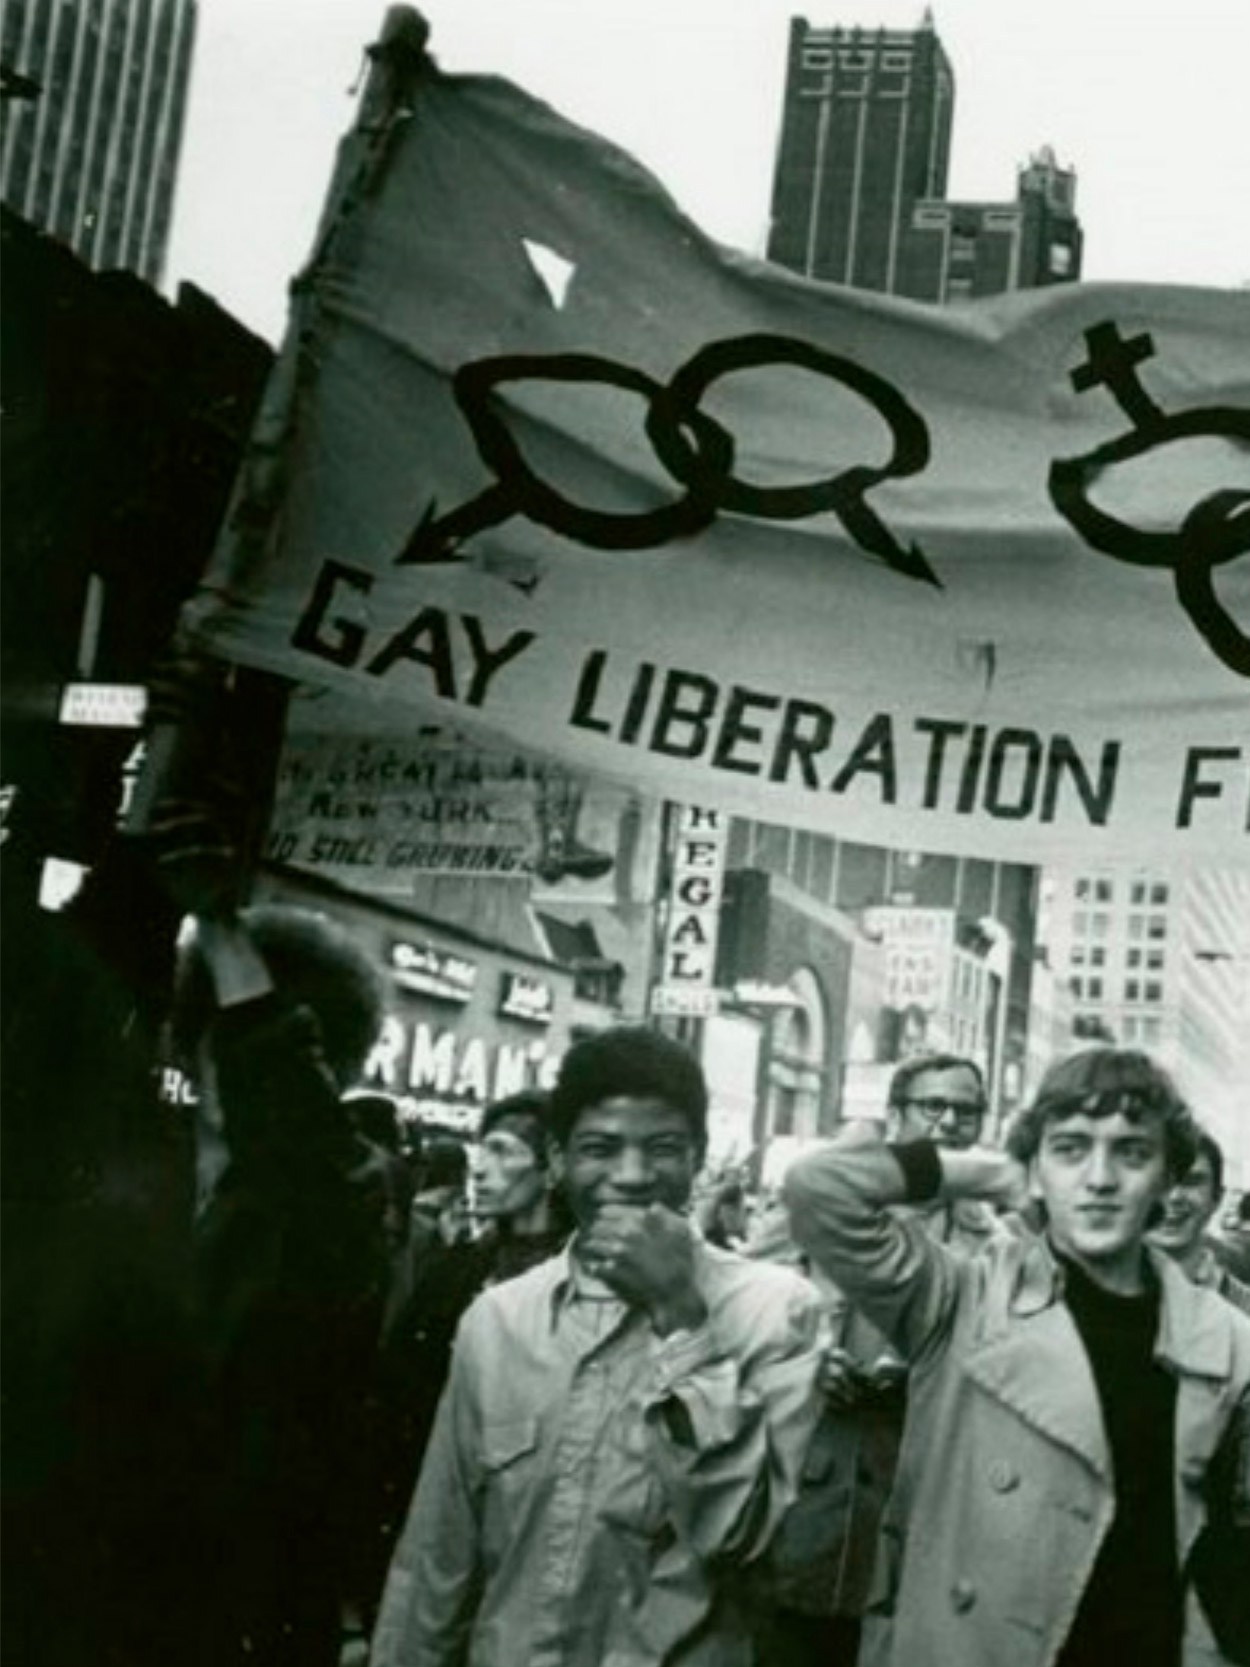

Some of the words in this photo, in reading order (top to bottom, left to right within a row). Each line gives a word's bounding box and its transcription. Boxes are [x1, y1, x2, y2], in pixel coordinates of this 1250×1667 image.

[290, 558, 538, 708] GAY
[568, 649, 1122, 827] LIBERATION
[669, 805, 721, 980] REGAL
